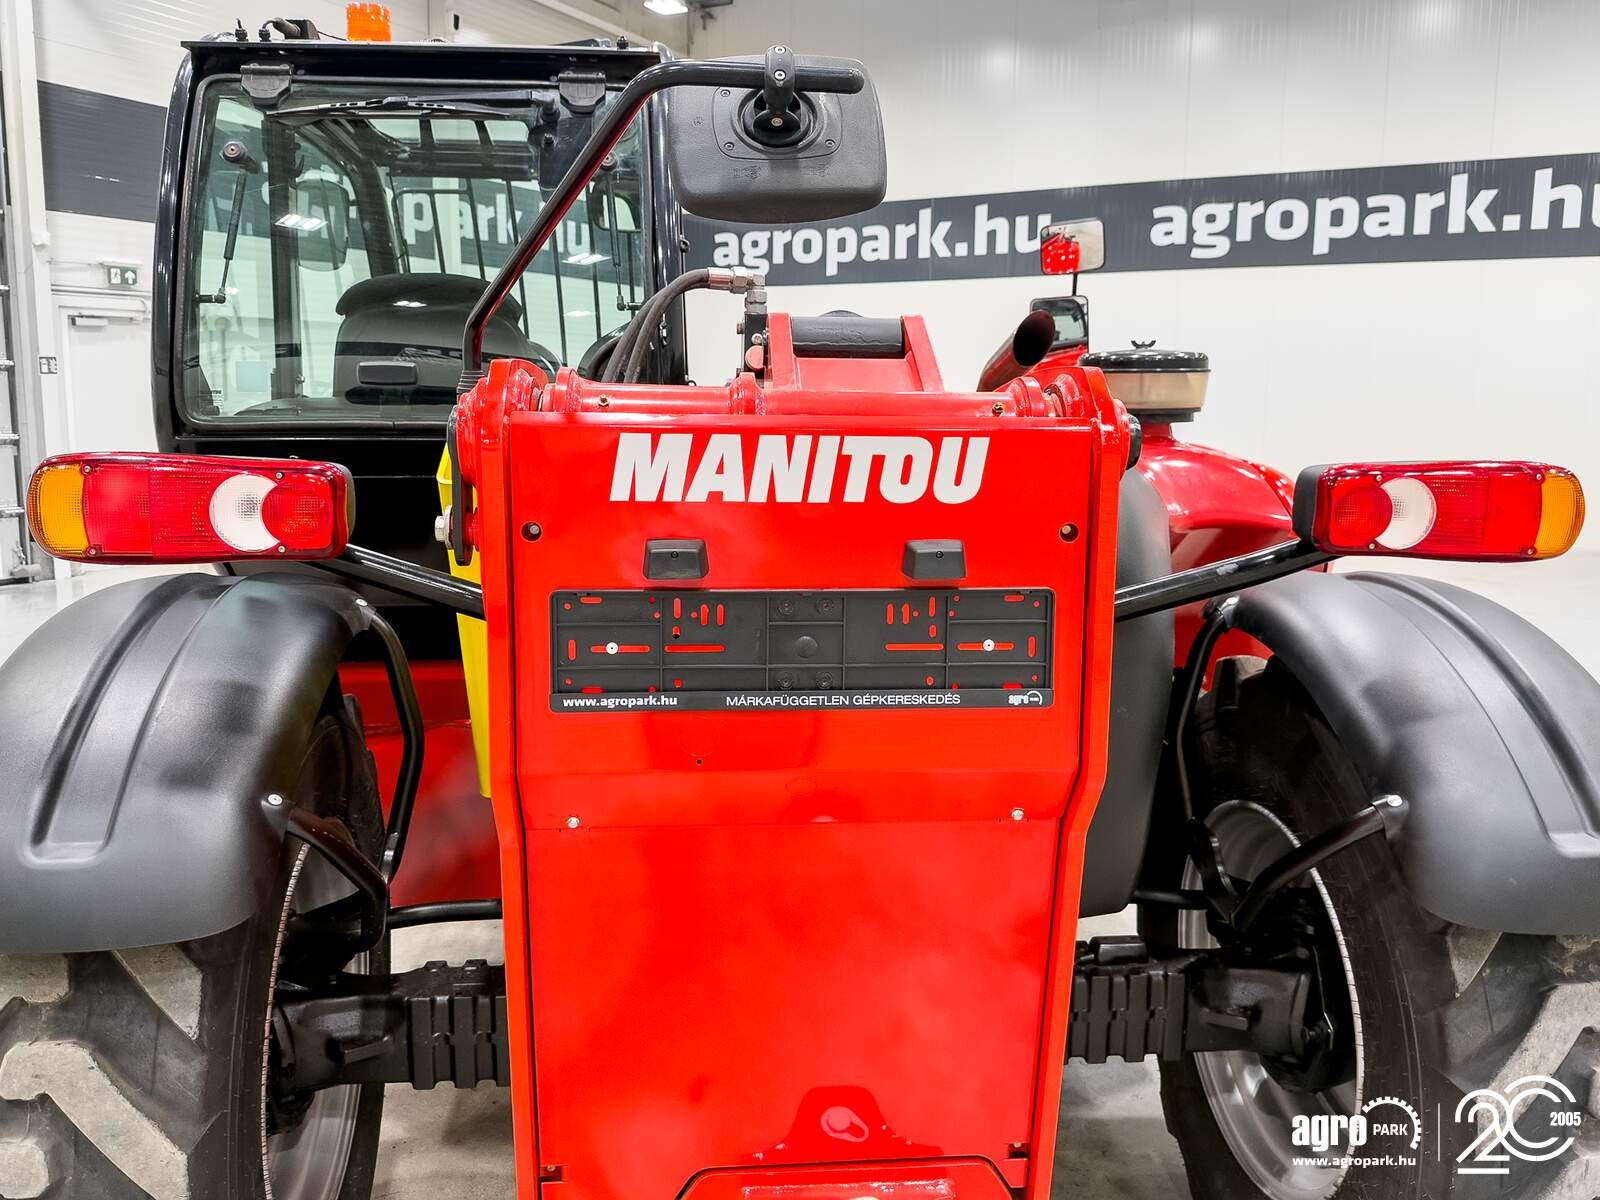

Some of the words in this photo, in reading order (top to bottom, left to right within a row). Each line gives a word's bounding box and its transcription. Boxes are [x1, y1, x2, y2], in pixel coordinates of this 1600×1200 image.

[713, 203, 1052, 276] agropark.hu
[1150, 167, 1600, 259] agropark.h
[609, 432, 990, 504] MANITOU
[563, 695, 678, 708] www.agropark.hu
[726, 694, 849, 706] MÁRKAFÜGGETLEN
[853, 693, 961, 705] GÉPKERESKEDÉS
